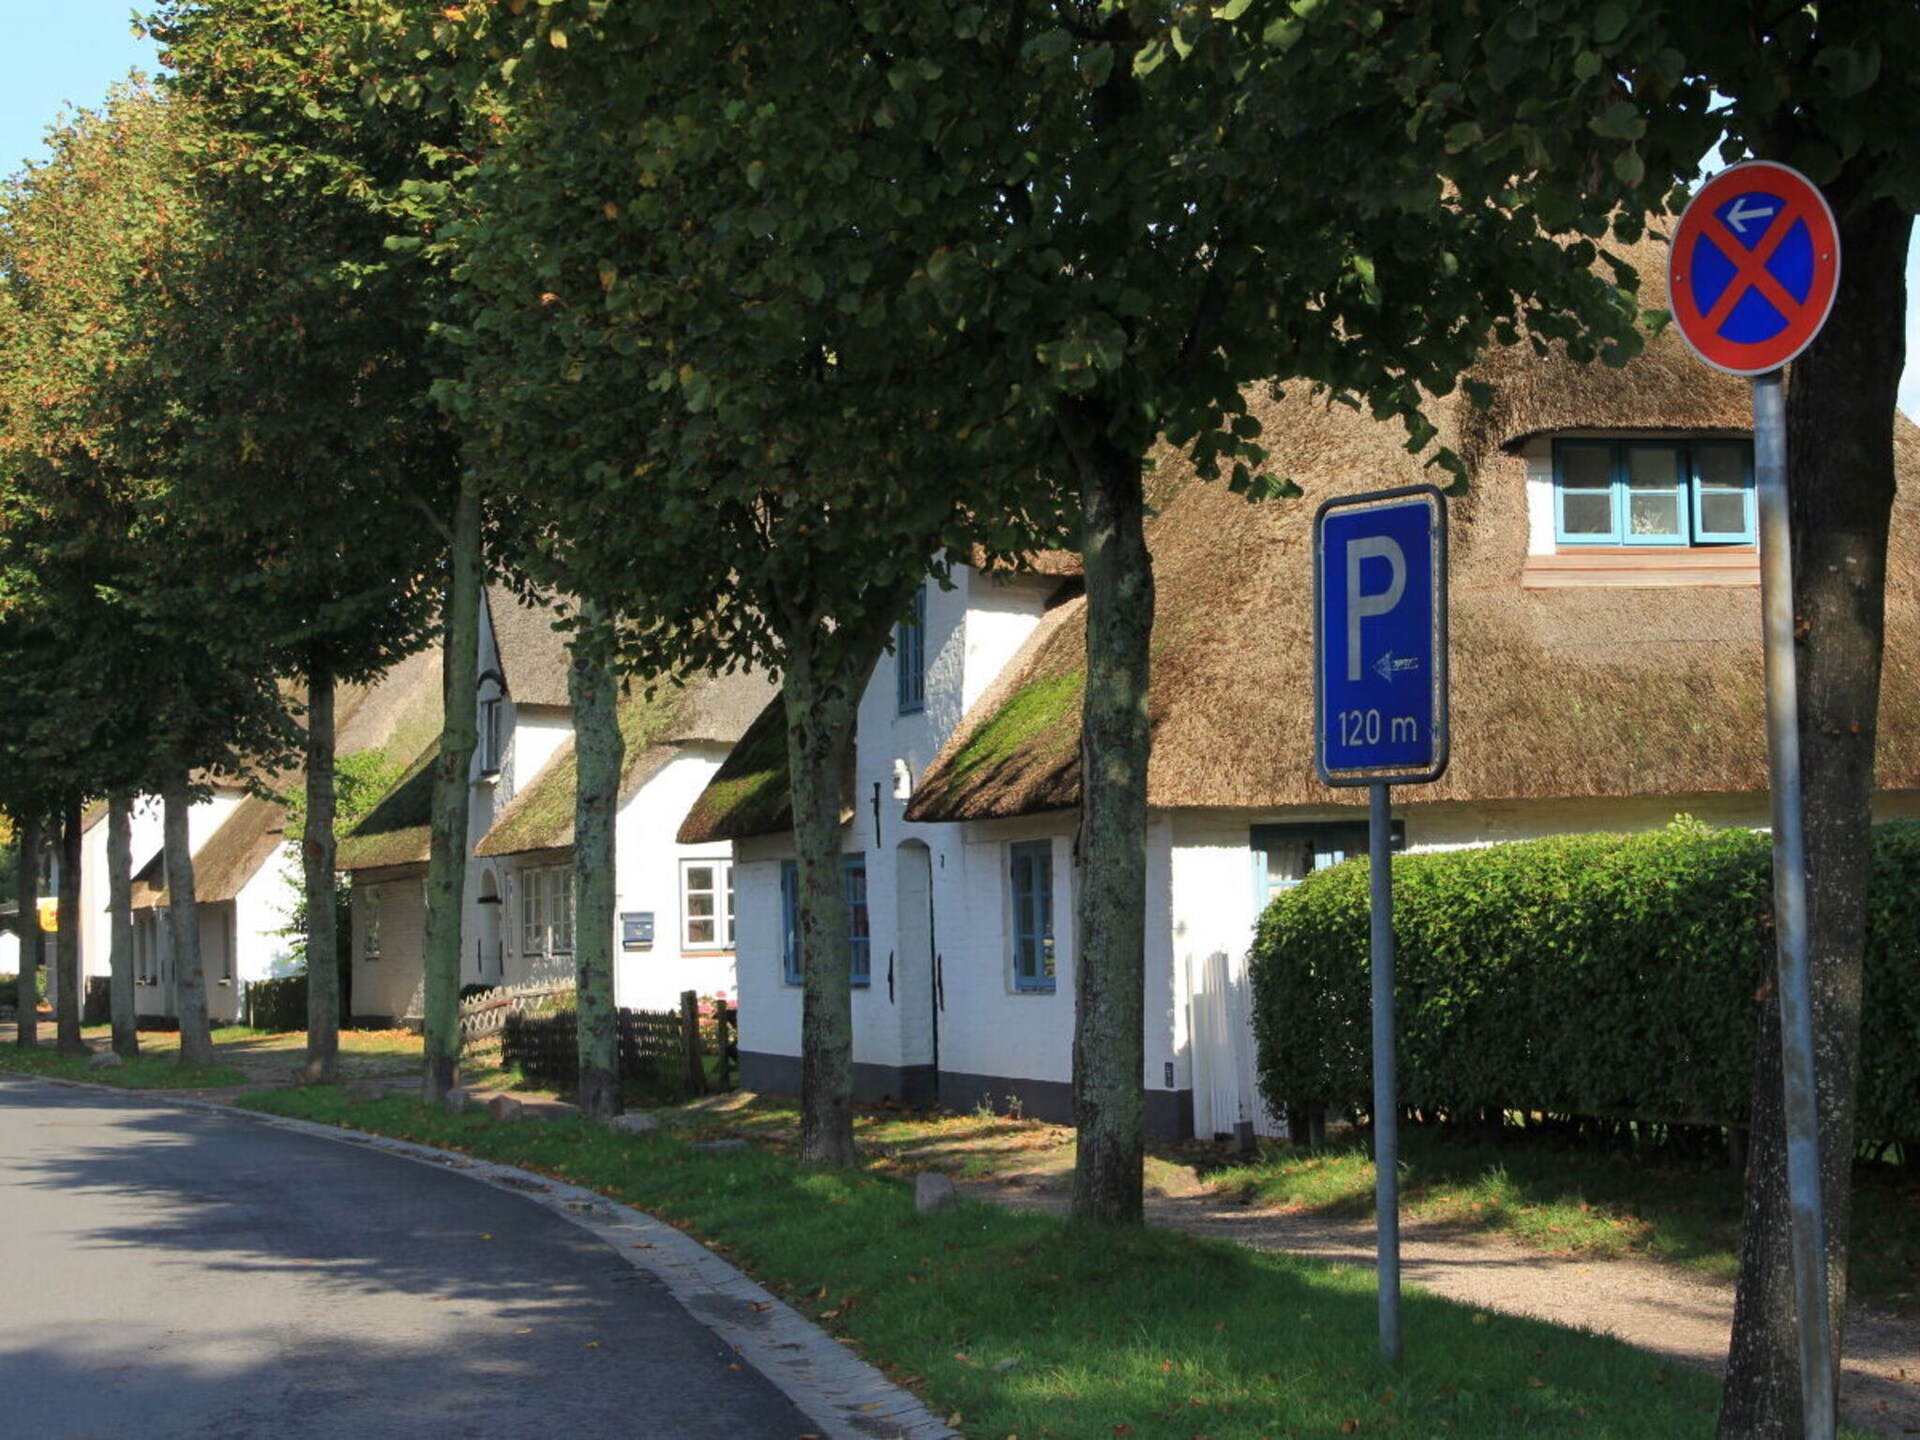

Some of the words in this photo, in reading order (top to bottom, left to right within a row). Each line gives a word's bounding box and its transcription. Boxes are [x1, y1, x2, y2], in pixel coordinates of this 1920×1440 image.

[1346, 535, 1406, 681] P
[1338, 708, 1380, 747] 120
[1391, 716, 1417, 743] m
